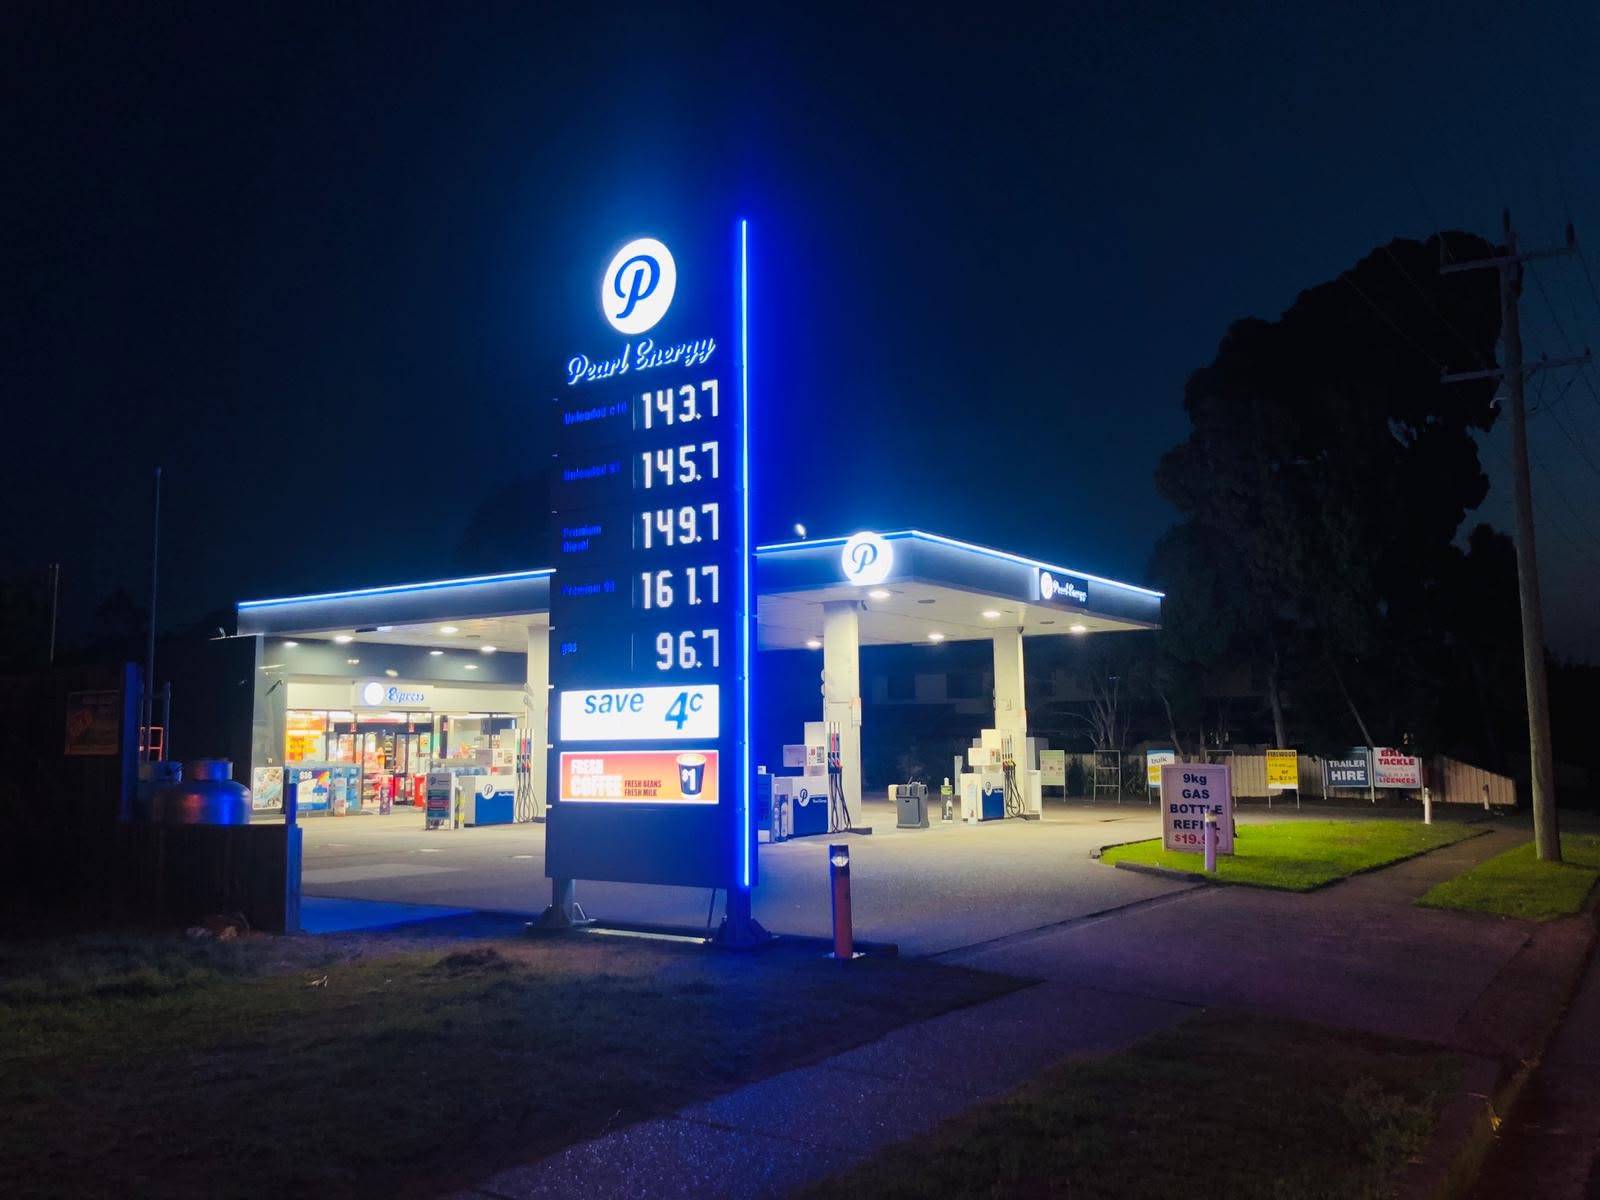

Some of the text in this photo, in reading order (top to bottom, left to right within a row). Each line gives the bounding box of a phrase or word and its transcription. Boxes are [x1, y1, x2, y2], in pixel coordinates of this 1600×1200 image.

[614, 254, 661, 319] P
[567, 337, 716, 385] Pearl Energy
[641, 379, 719, 429] 143.7
[642, 441, 719, 488] 145.7
[641, 503, 719, 549] 149.7
[655, 628, 719, 670] 96.7
[584, 692, 644, 714] save
[571, 759, 604, 774] FRESH
[1328, 759, 1366, 768] TRAILER
[1378, 758, 1416, 766] TACKLE
[1183, 773, 1207, 785] 9kg
[1331, 770, 1366, 781] HIRE
[1379, 777, 1416, 785] LICENCES
[571, 774, 623, 797] COFFEE
[624, 780, 662, 788] FRESH BEANS
[624, 789, 657, 797] FRESH MILK
[1182, 789, 1210, 799] GAS
[1173, 819, 1221, 831] REFI
[1174, 833, 1220, 845] $19.
